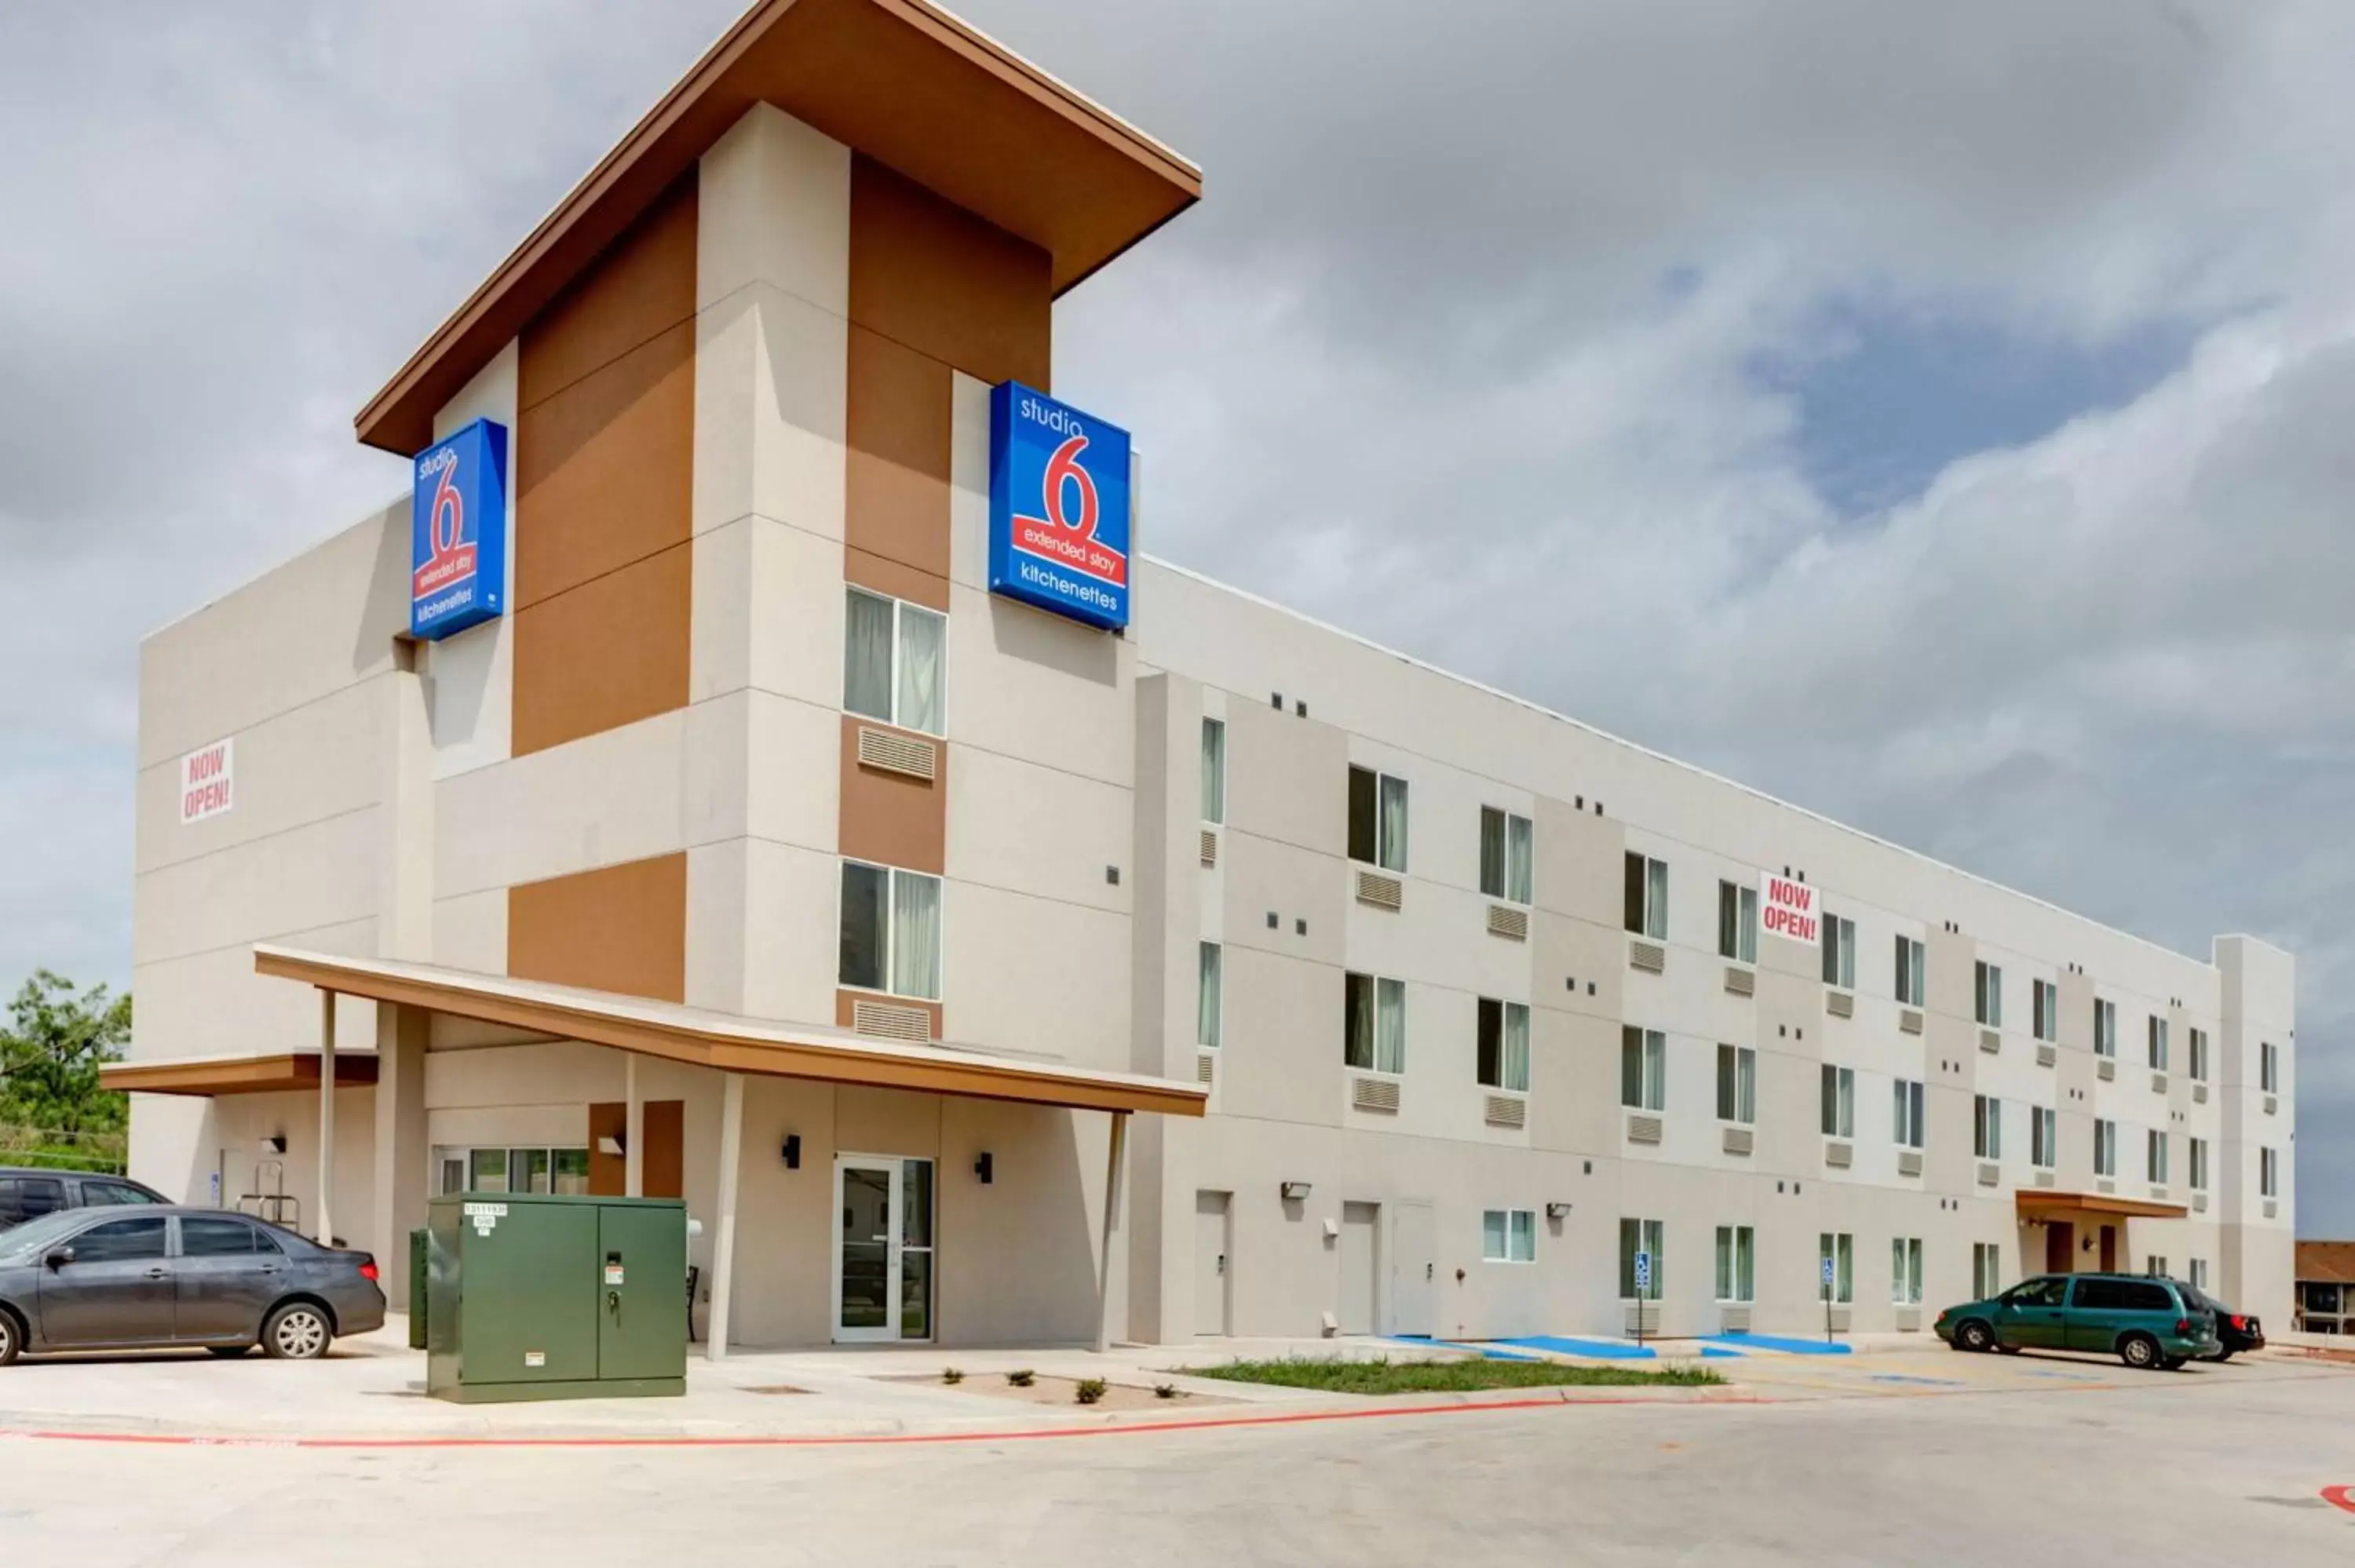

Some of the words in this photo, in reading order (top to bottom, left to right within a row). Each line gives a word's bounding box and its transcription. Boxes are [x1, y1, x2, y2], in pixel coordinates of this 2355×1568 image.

[1020, 399, 1083, 436] studio
[419, 447, 455, 480] studio
[430, 454, 462, 552] 6
[1042, 435, 1099, 538] 6
[1024, 527, 1086, 562] extended
[1090, 551, 1116, 577] stay
[1021, 562, 1117, 611] kitchenettes
[189, 745, 225, 785] NOW
[184, 778, 228, 818] OPEN!
[1770, 878, 1811, 910] NOW
[1764, 906, 1816, 941] OPEN!
